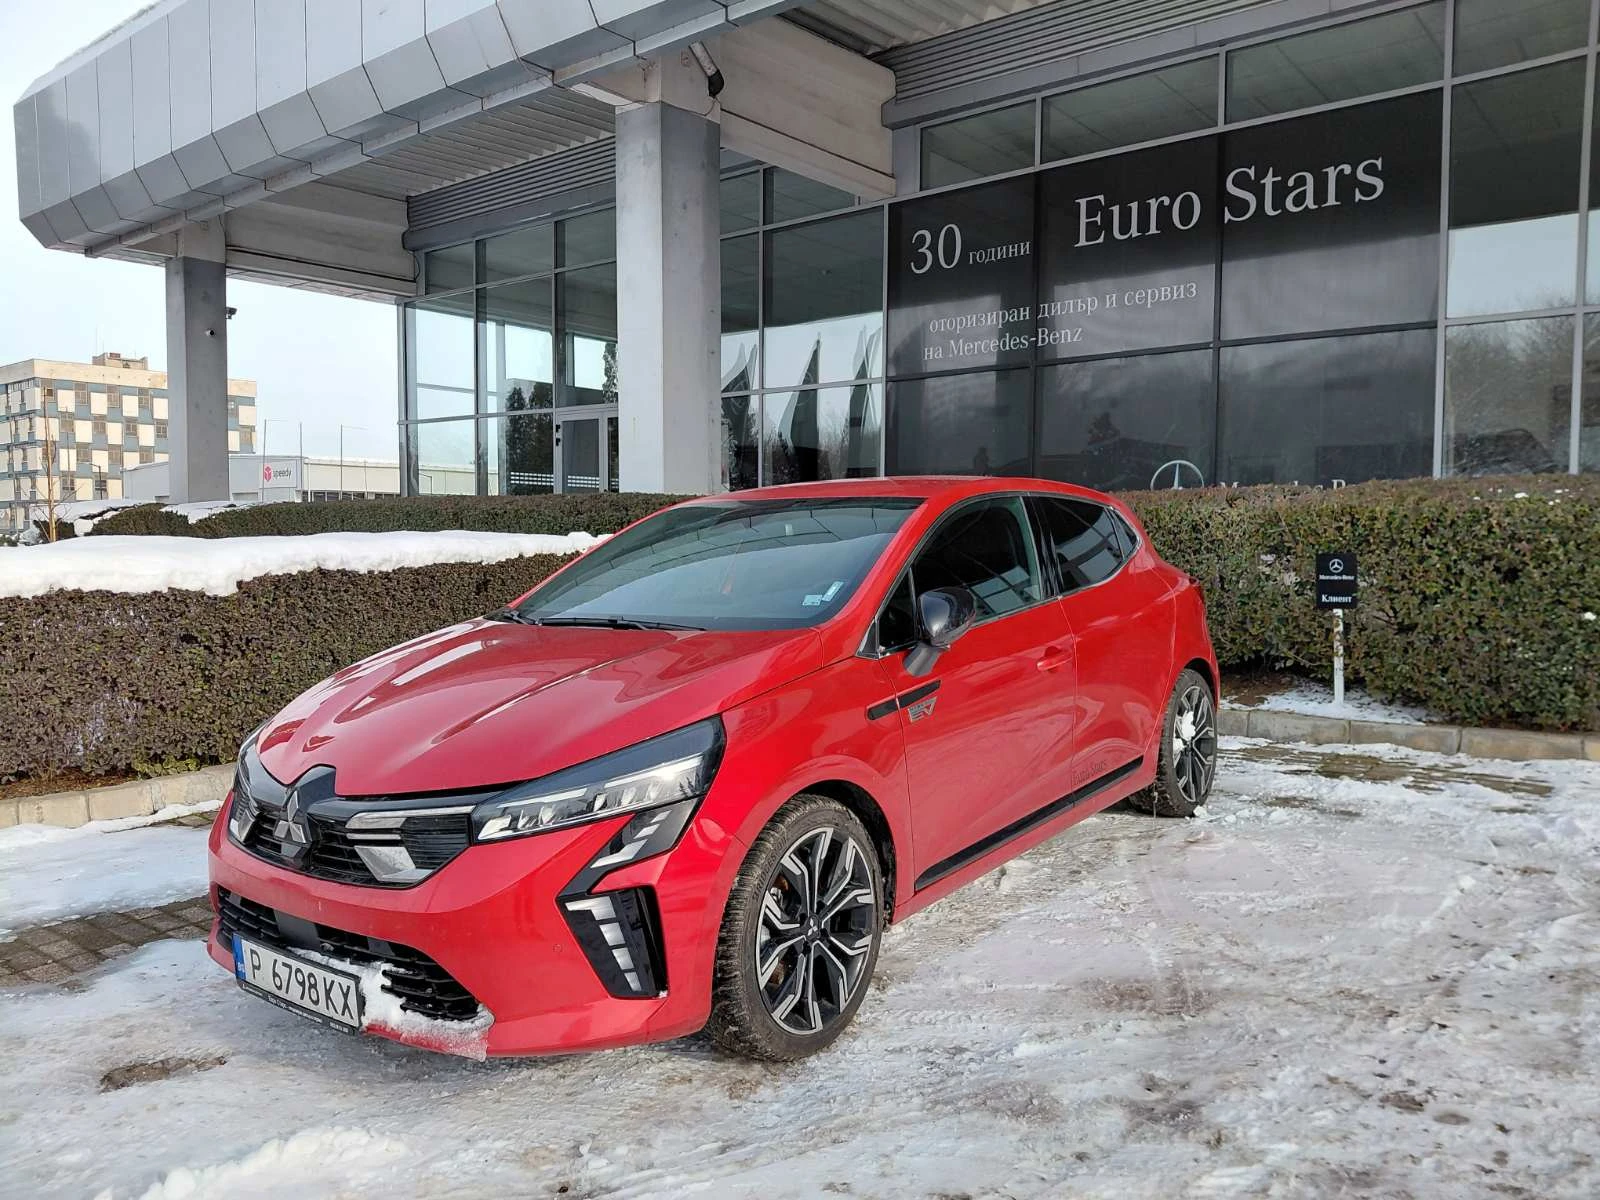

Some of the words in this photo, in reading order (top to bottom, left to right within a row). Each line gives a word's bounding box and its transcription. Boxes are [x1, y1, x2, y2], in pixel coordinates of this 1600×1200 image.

[1074, 191, 1201, 248] Euro
[1224, 157, 1385, 224] Stars
[910, 223, 962, 274] 30
[969, 241, 1032, 265] години
[929, 304, 1030, 333] оторизиран
[1037, 295, 1098, 319] дилър
[1105, 292, 1117, 309] и
[1124, 281, 1197, 309] сервиз
[924, 343, 944, 361] на
[949, 326, 1083, 359] Mercedes-Benz
[1321, 594, 1353, 603] Клиент
